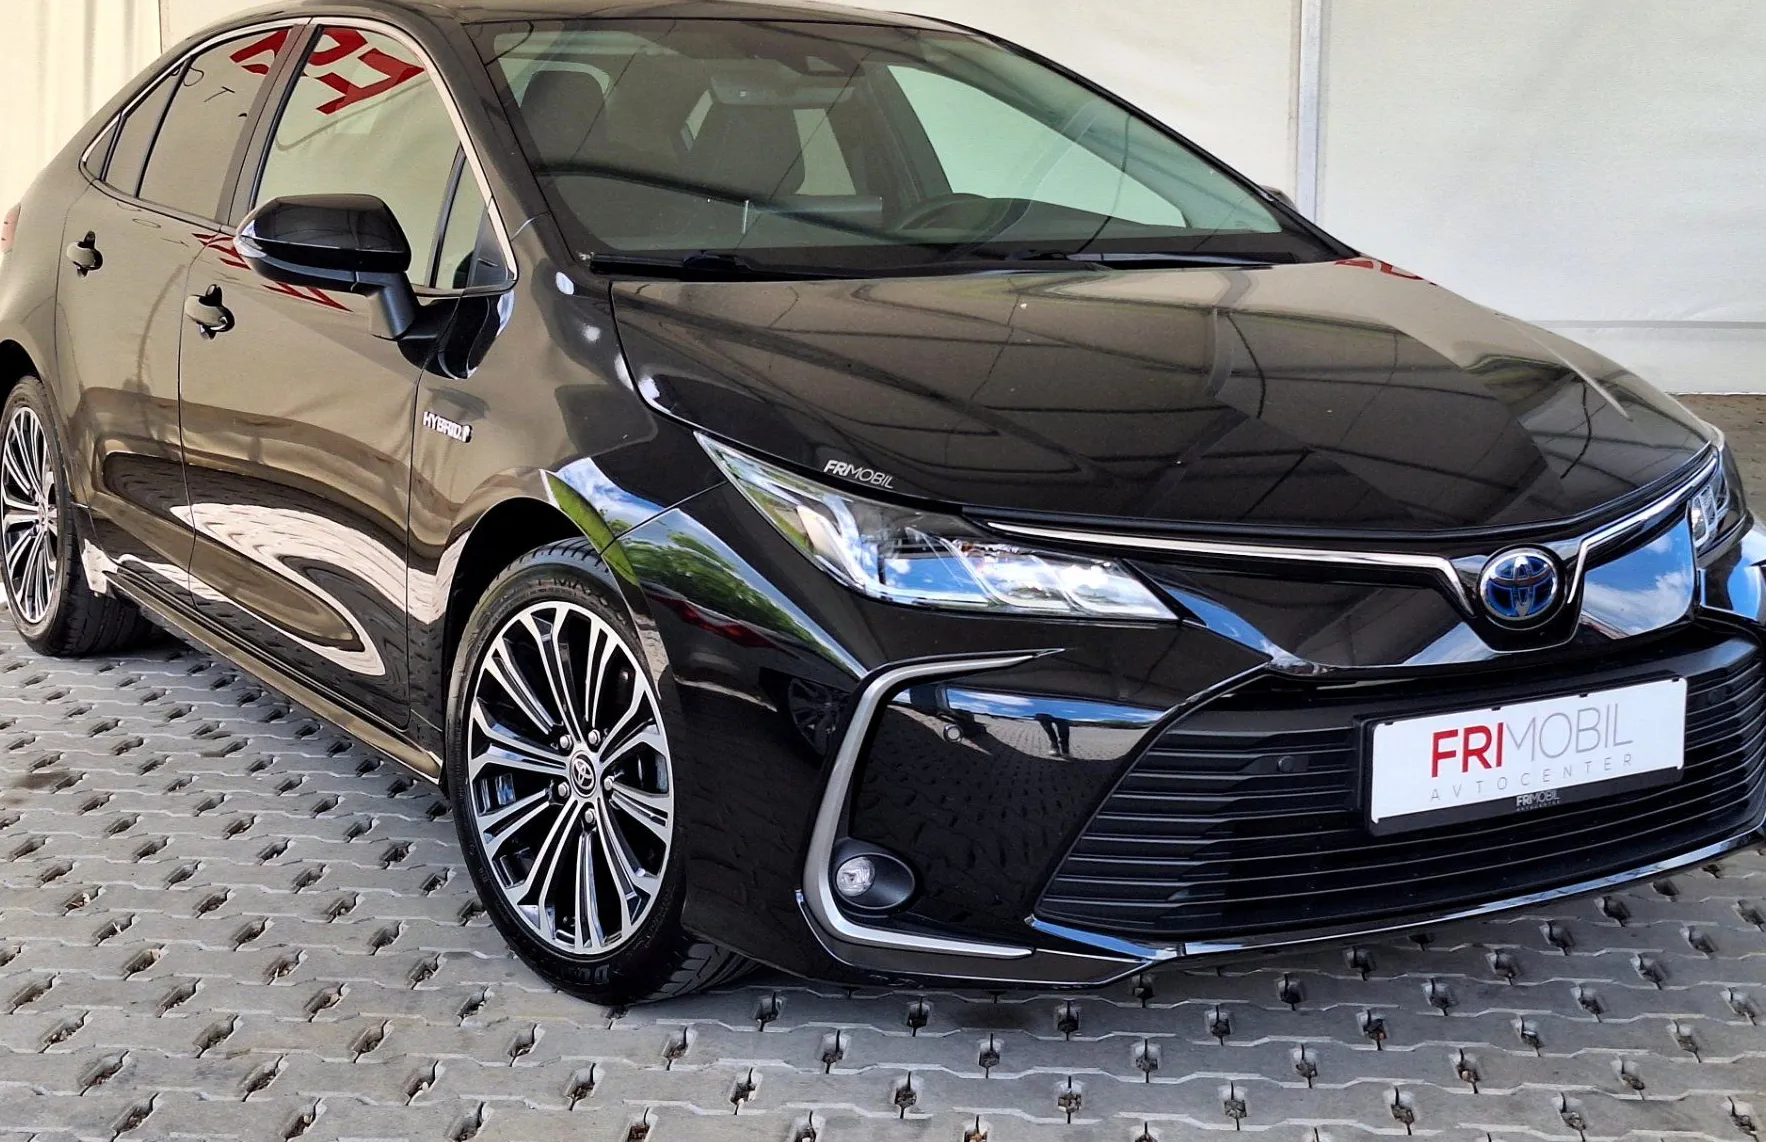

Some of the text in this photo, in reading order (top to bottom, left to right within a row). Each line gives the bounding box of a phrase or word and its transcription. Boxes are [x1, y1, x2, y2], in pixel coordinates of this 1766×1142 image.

[423, 411, 462, 440] HYBRID
[1430, 703, 1634, 778] FRIMOBIL
[1430, 753, 1633, 802] AVTOCENTER
